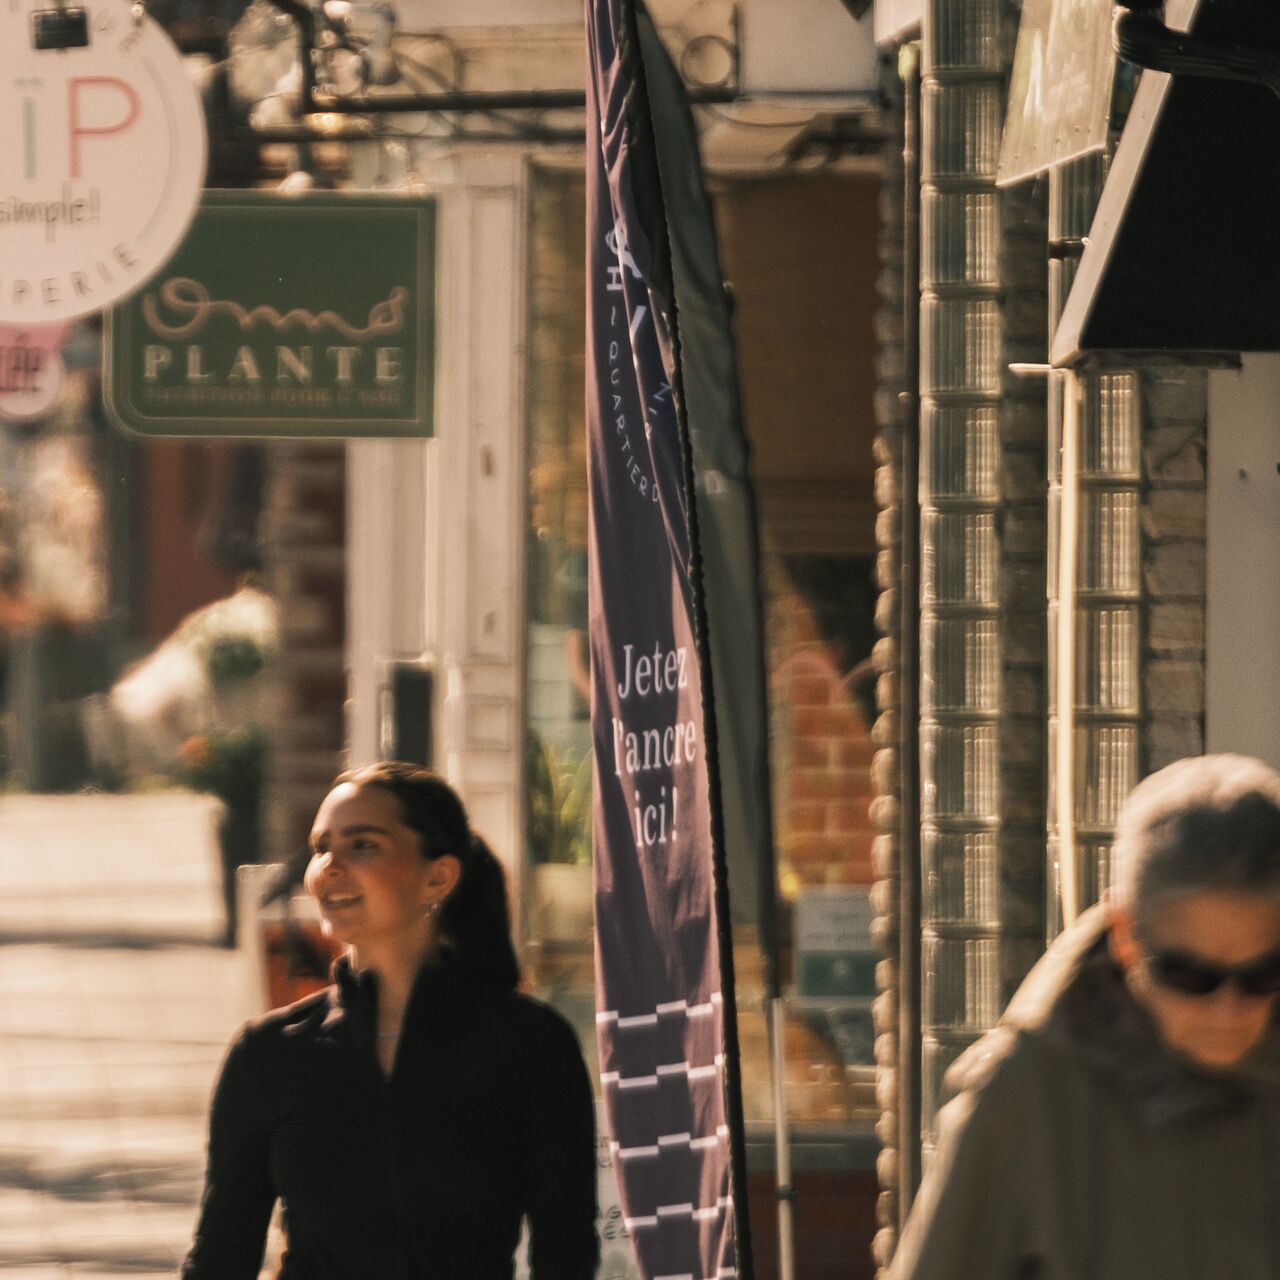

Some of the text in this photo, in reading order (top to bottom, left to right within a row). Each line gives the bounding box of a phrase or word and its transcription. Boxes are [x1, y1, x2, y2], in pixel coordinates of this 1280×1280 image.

[143, 344, 403, 382] PLANTE
[618, 640, 688, 699] Jetez
[612, 716, 697, 777] l'ancre
